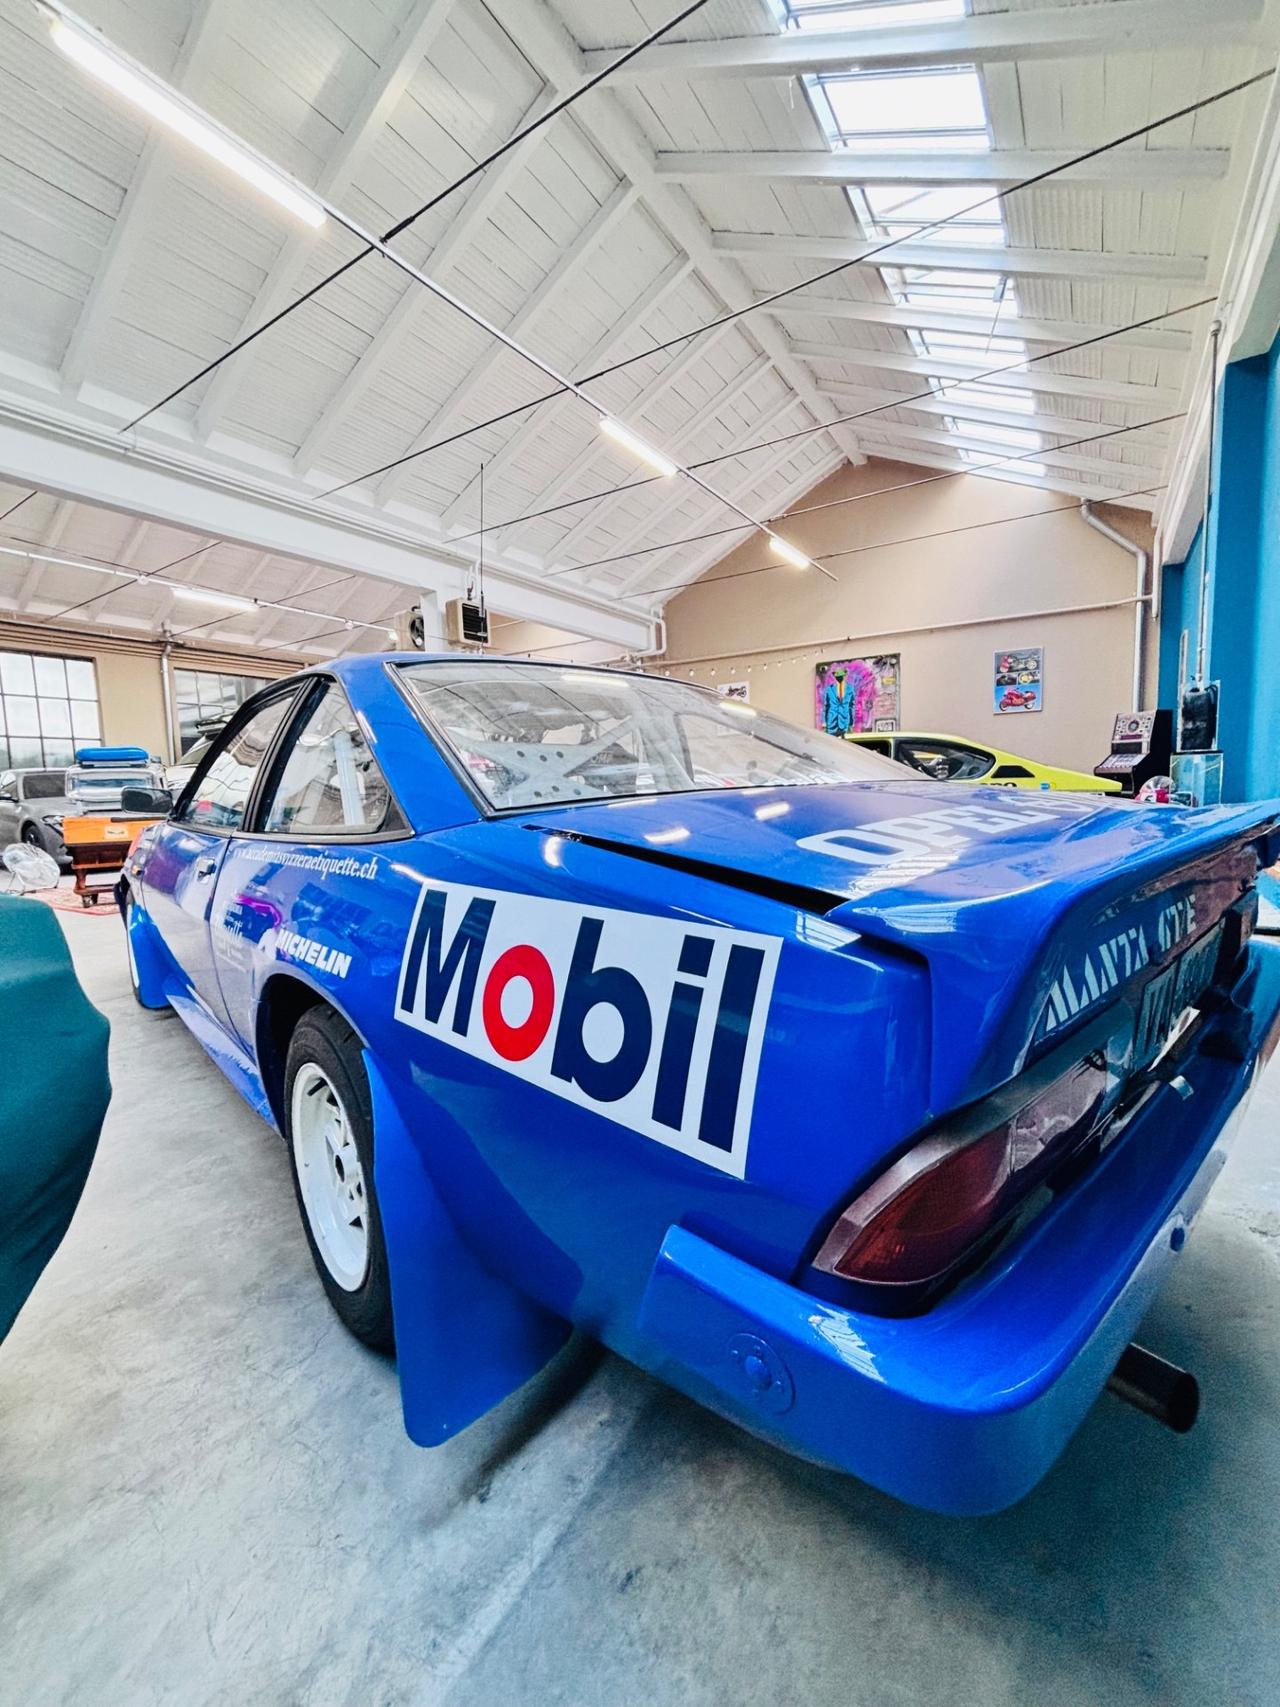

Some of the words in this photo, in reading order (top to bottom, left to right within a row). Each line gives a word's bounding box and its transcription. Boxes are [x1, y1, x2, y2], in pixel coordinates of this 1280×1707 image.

[796, 804, 1061, 865] OPEL
[275, 927, 353, 979] MICHELIN
[1045, 923, 1150, 1032] MANTA
[400, 889, 766, 1154] Mobil
